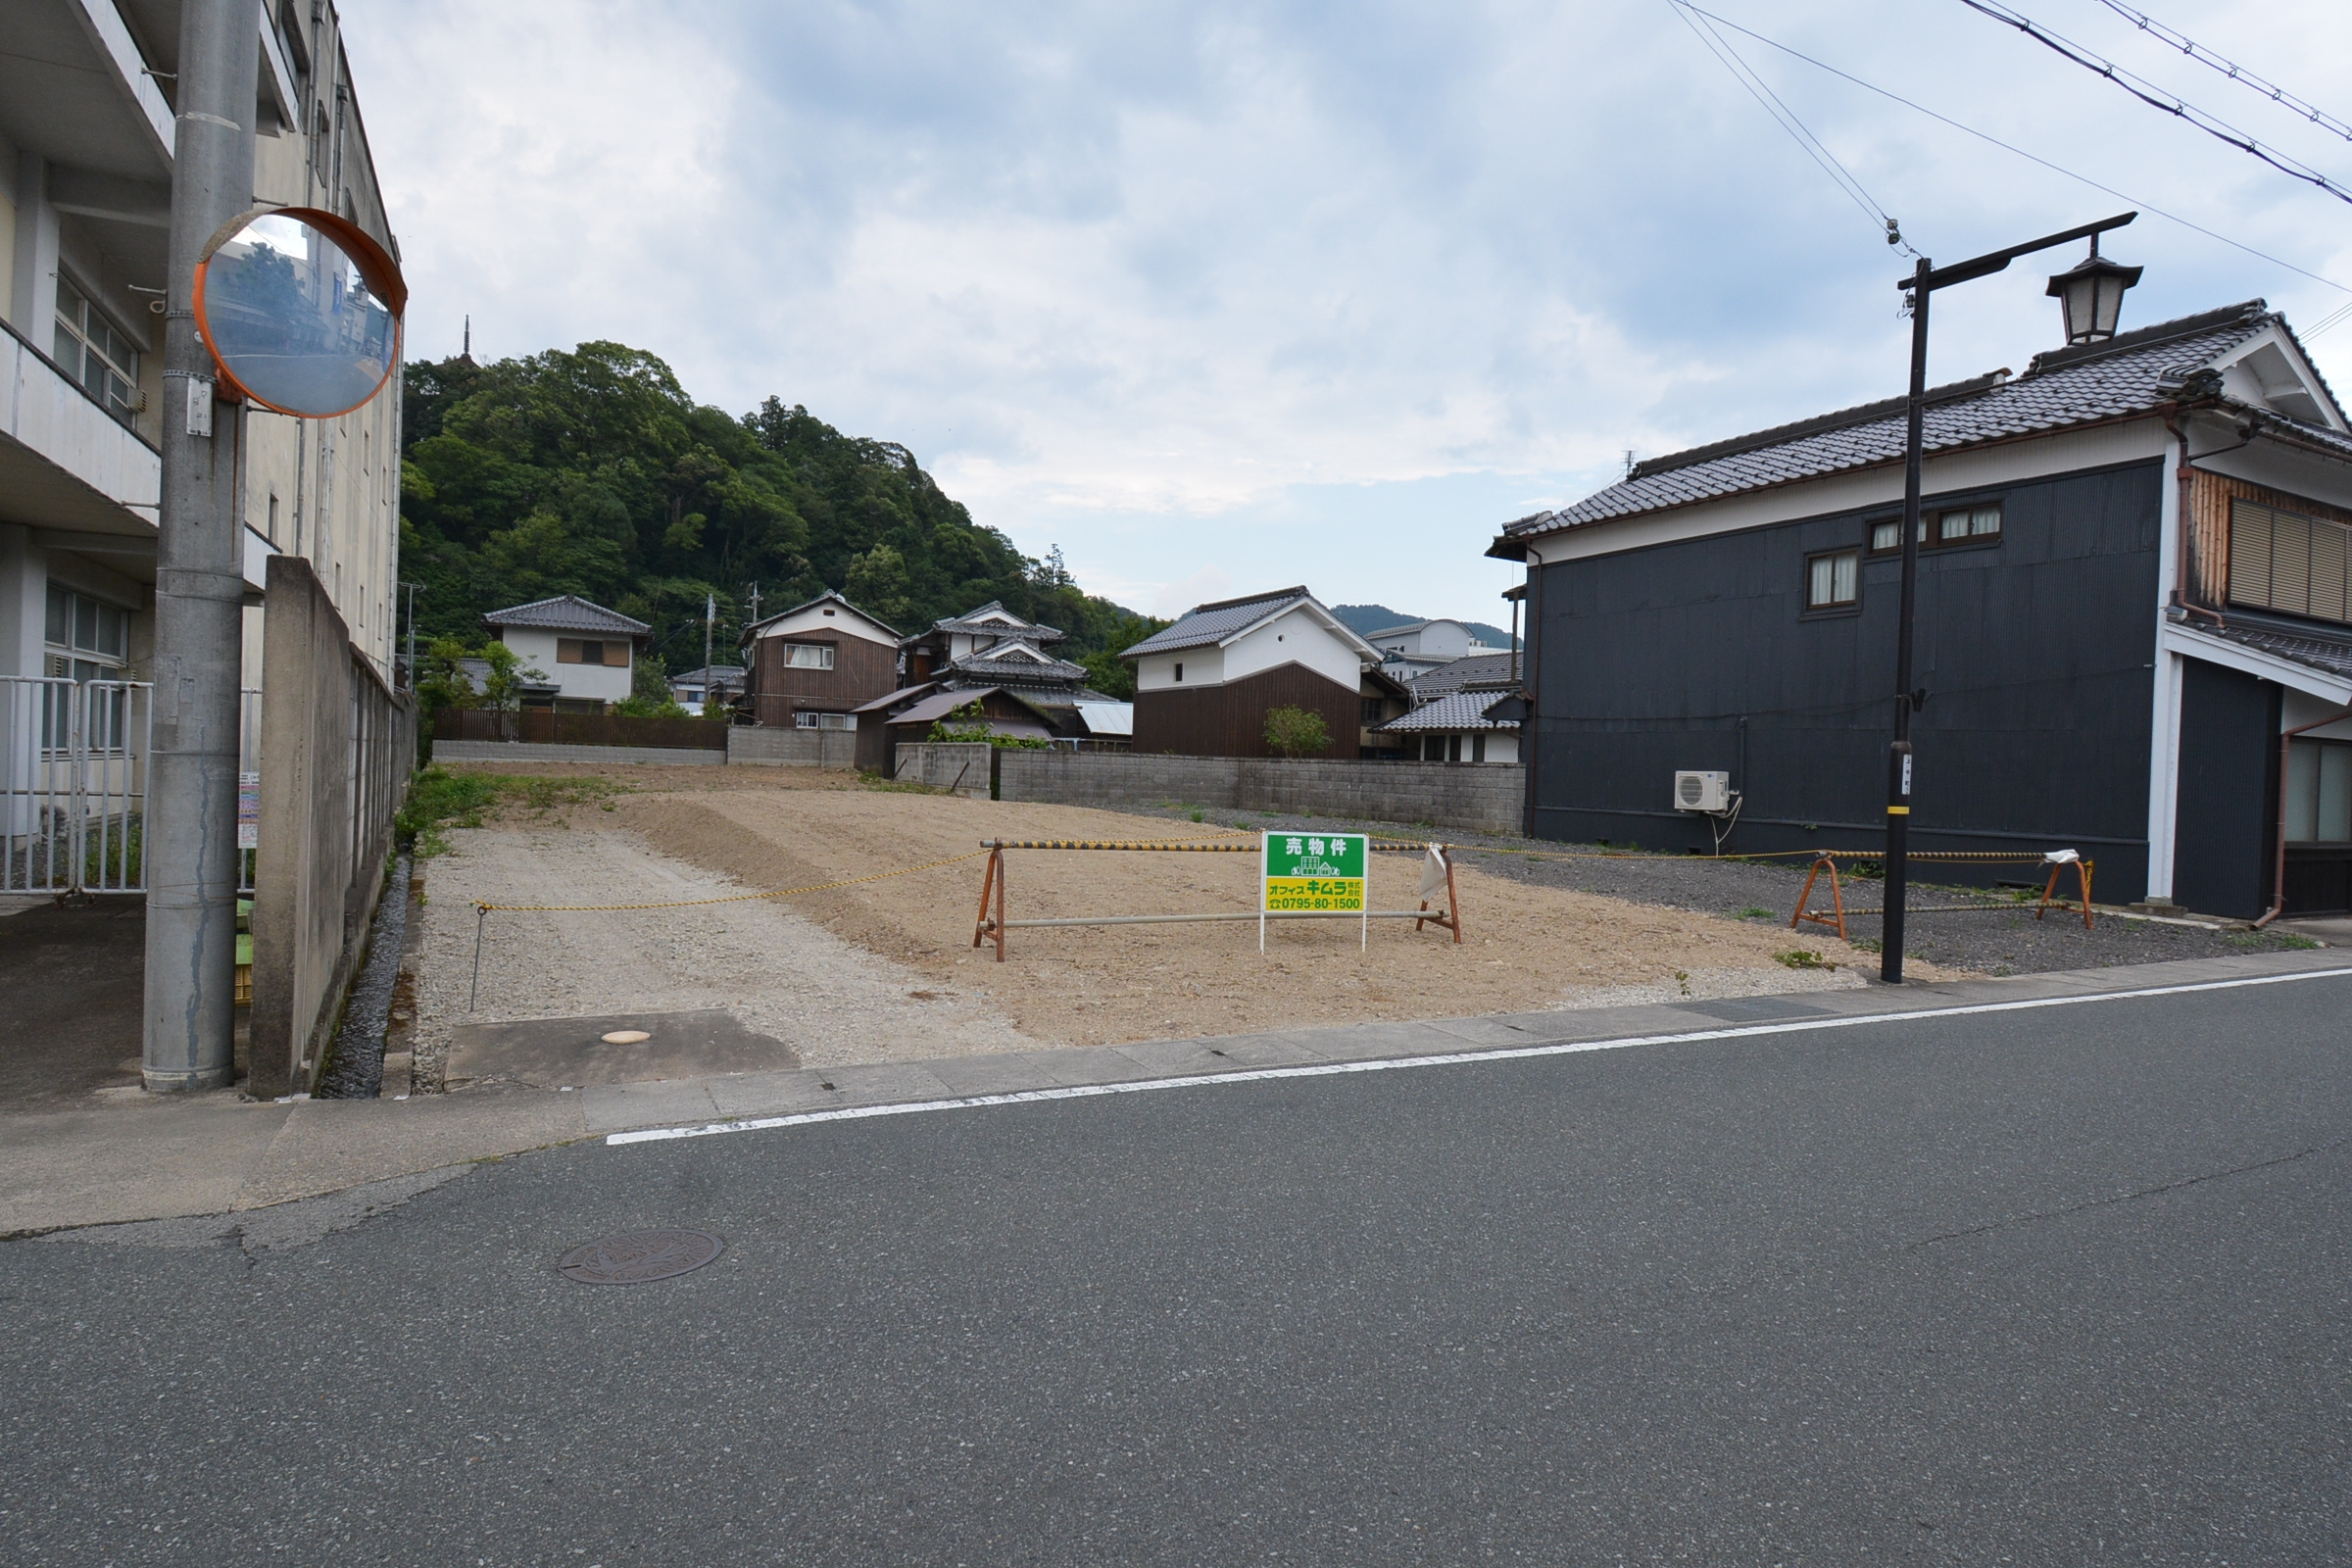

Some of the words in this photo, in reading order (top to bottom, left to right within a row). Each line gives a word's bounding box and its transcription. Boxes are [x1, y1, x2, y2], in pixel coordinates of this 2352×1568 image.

[1286, 837, 1347, 857] 売物件
[1282, 898, 1360, 909] 0795-80-1500
